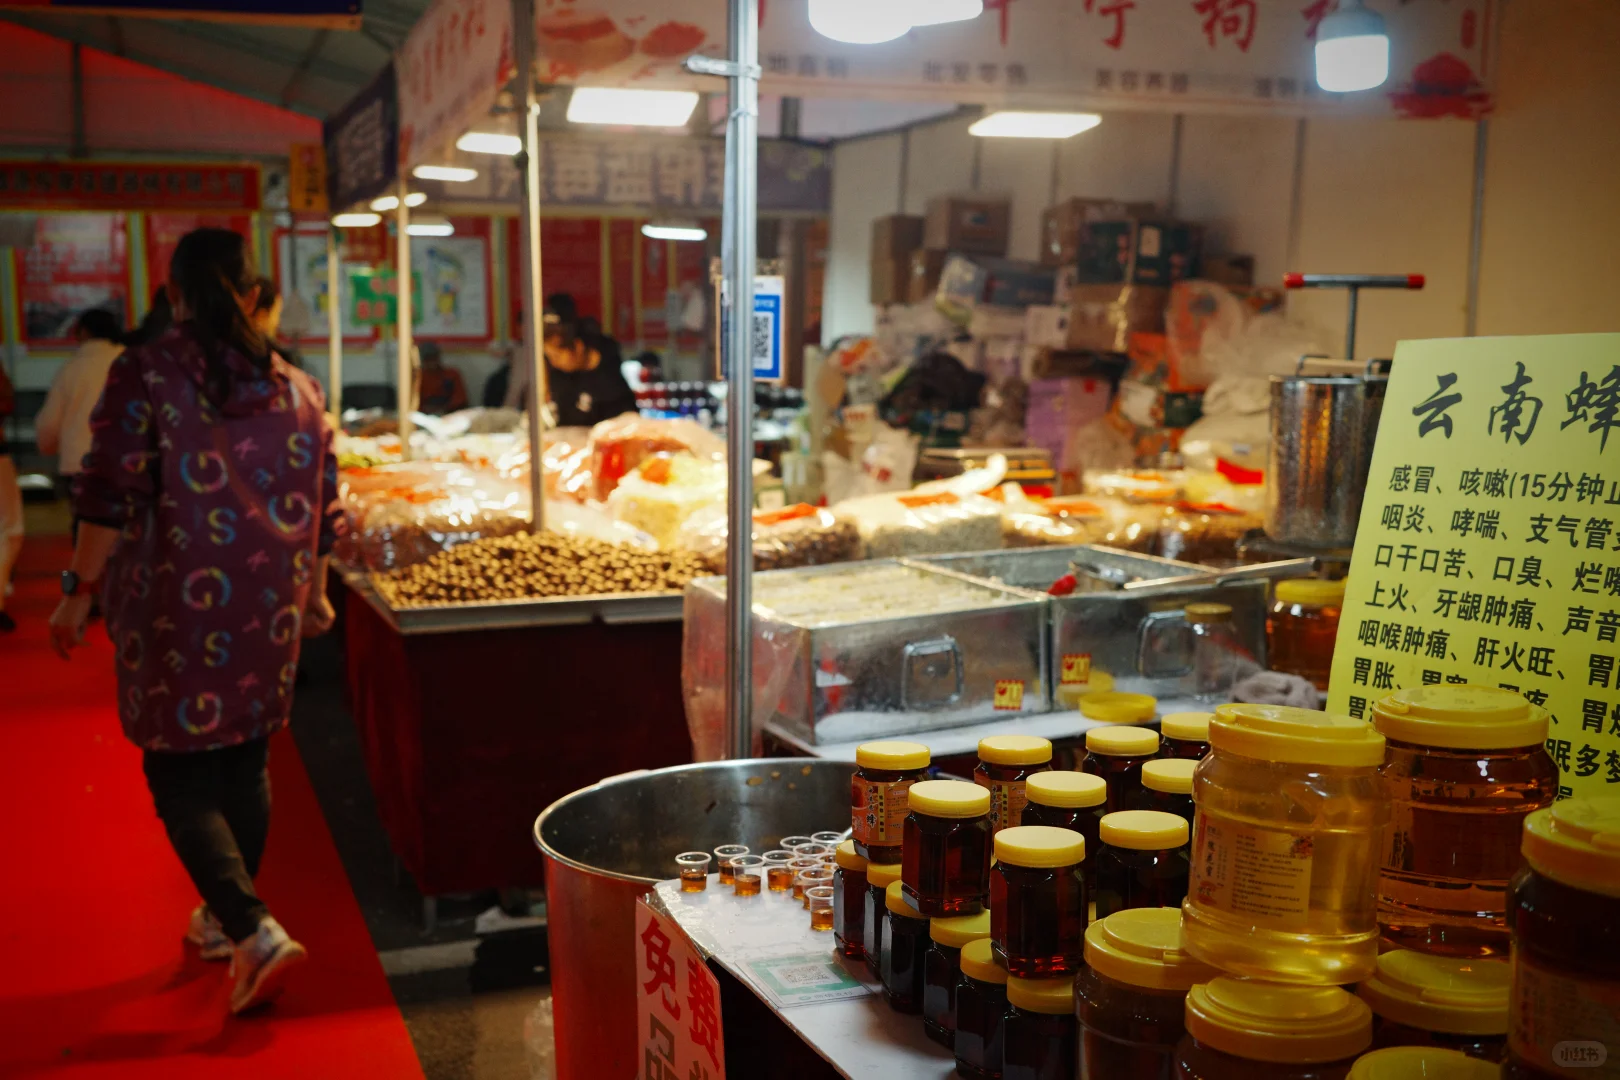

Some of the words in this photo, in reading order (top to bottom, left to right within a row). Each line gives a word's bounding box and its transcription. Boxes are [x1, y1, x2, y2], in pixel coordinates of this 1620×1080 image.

[1412, 361, 1620, 455] 云南蜂
[287, 432, 312, 469] S
[208, 507, 237, 545] S
[1380, 504, 1620, 552] 咽炎、哮喘、支气管
[204, 631, 232, 667] S
[1358, 619, 1620, 689] 咽喉肿痛、肝火旺、胃
[641, 916, 720, 1071] 免费
